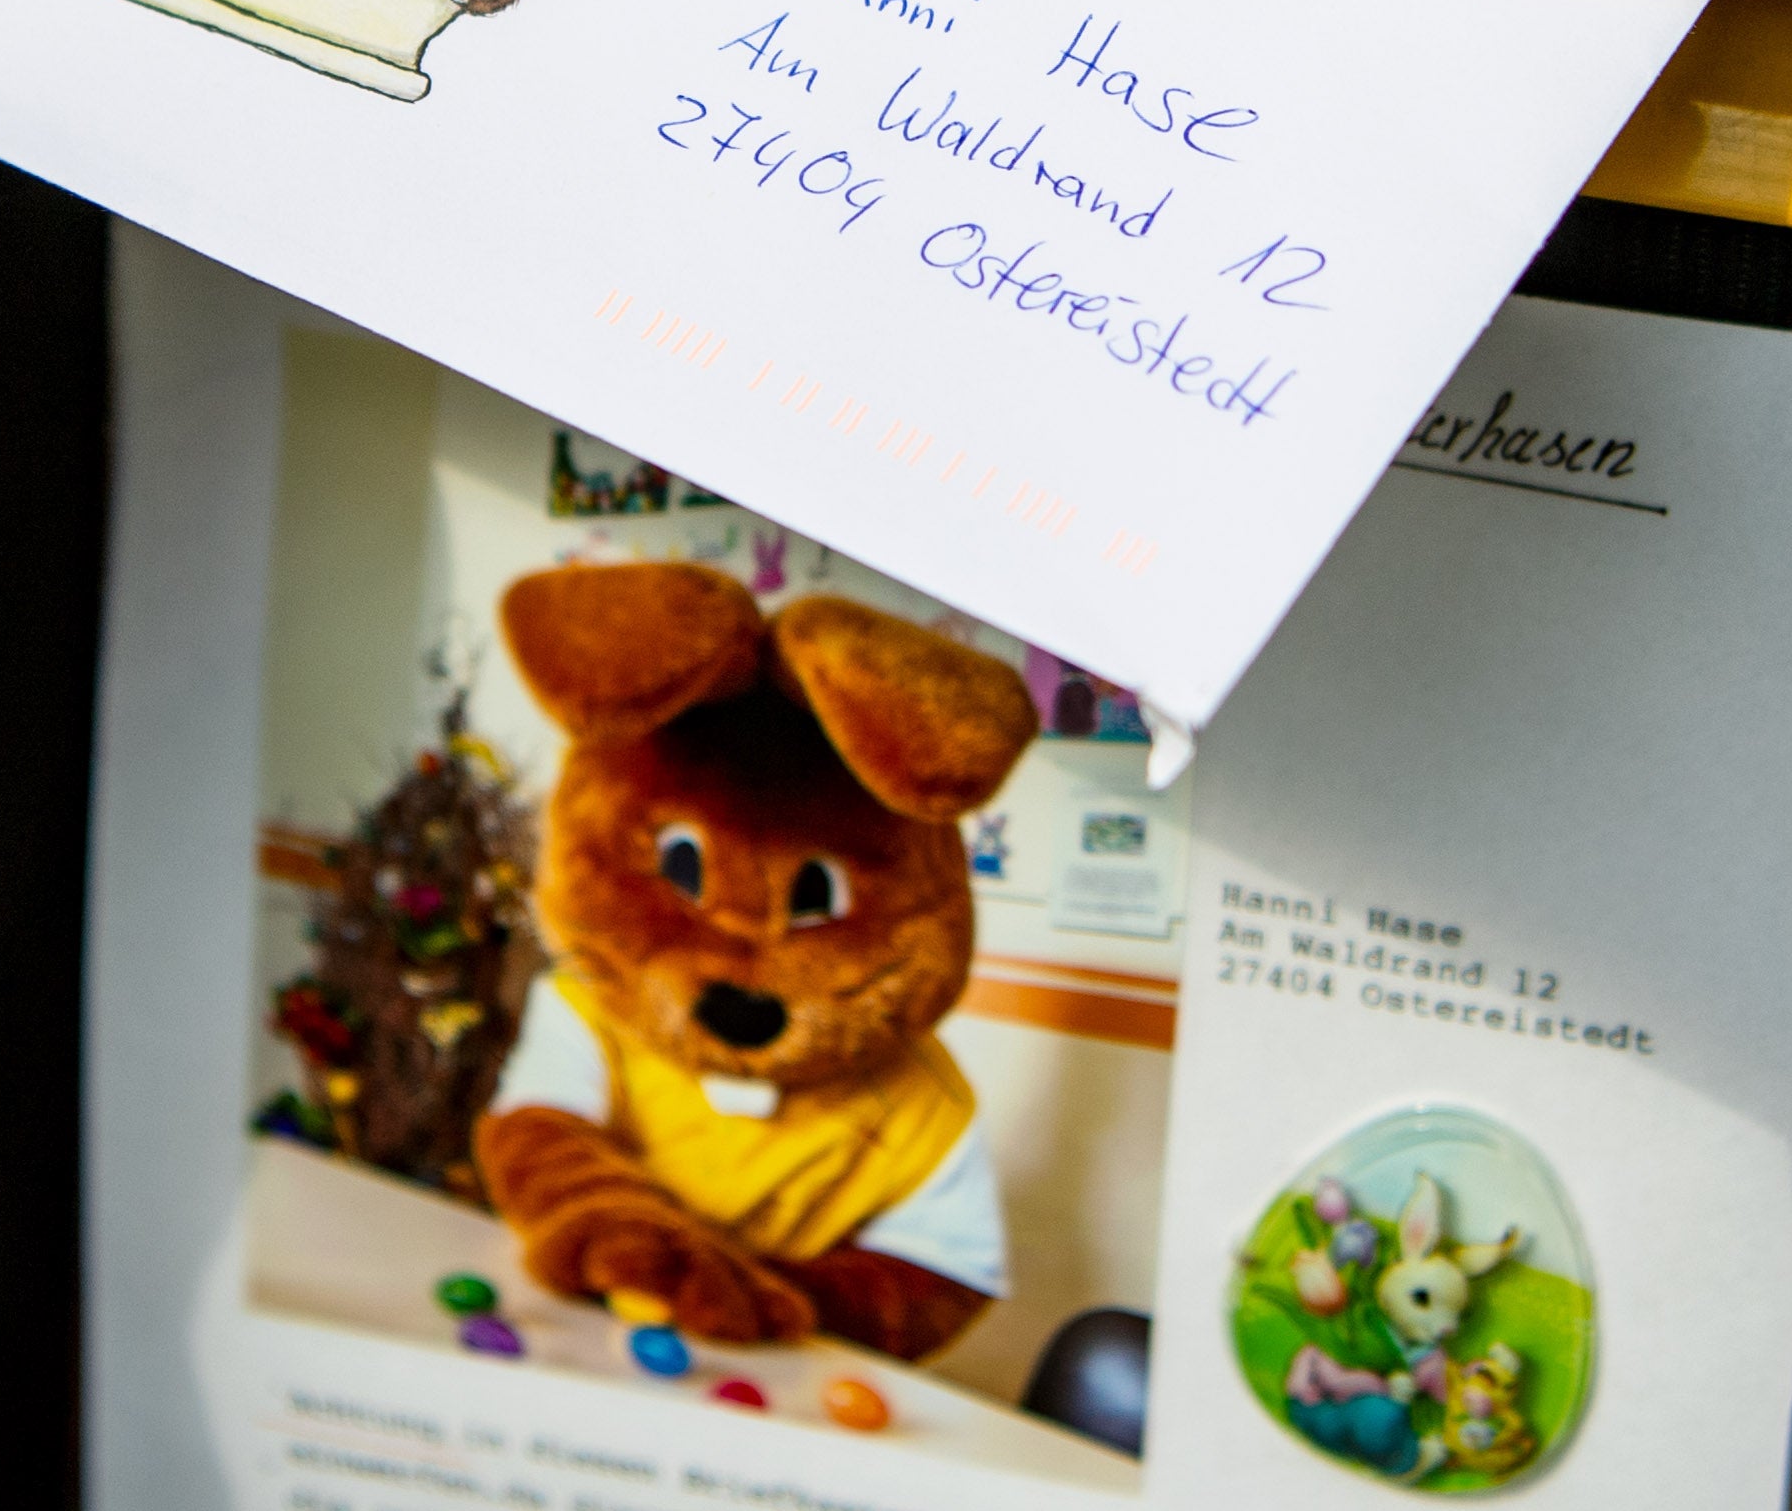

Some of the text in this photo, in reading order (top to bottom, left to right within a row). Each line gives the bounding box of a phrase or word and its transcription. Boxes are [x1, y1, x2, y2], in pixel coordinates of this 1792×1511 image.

[1046, 14, 1261, 164] Hase
[717, 11, 1333, 312] Am Waldrand 12
[656, 93, 1299, 428] 27404 Ostereistedt
[1406, 389, 1636, 478] erhasen
[1218, 918, 1560, 1002] Am Waldrand 12
[1222, 882, 1464, 947] Hanni Hase
[1217, 955, 1656, 1057] 27404 Ostereistedt
